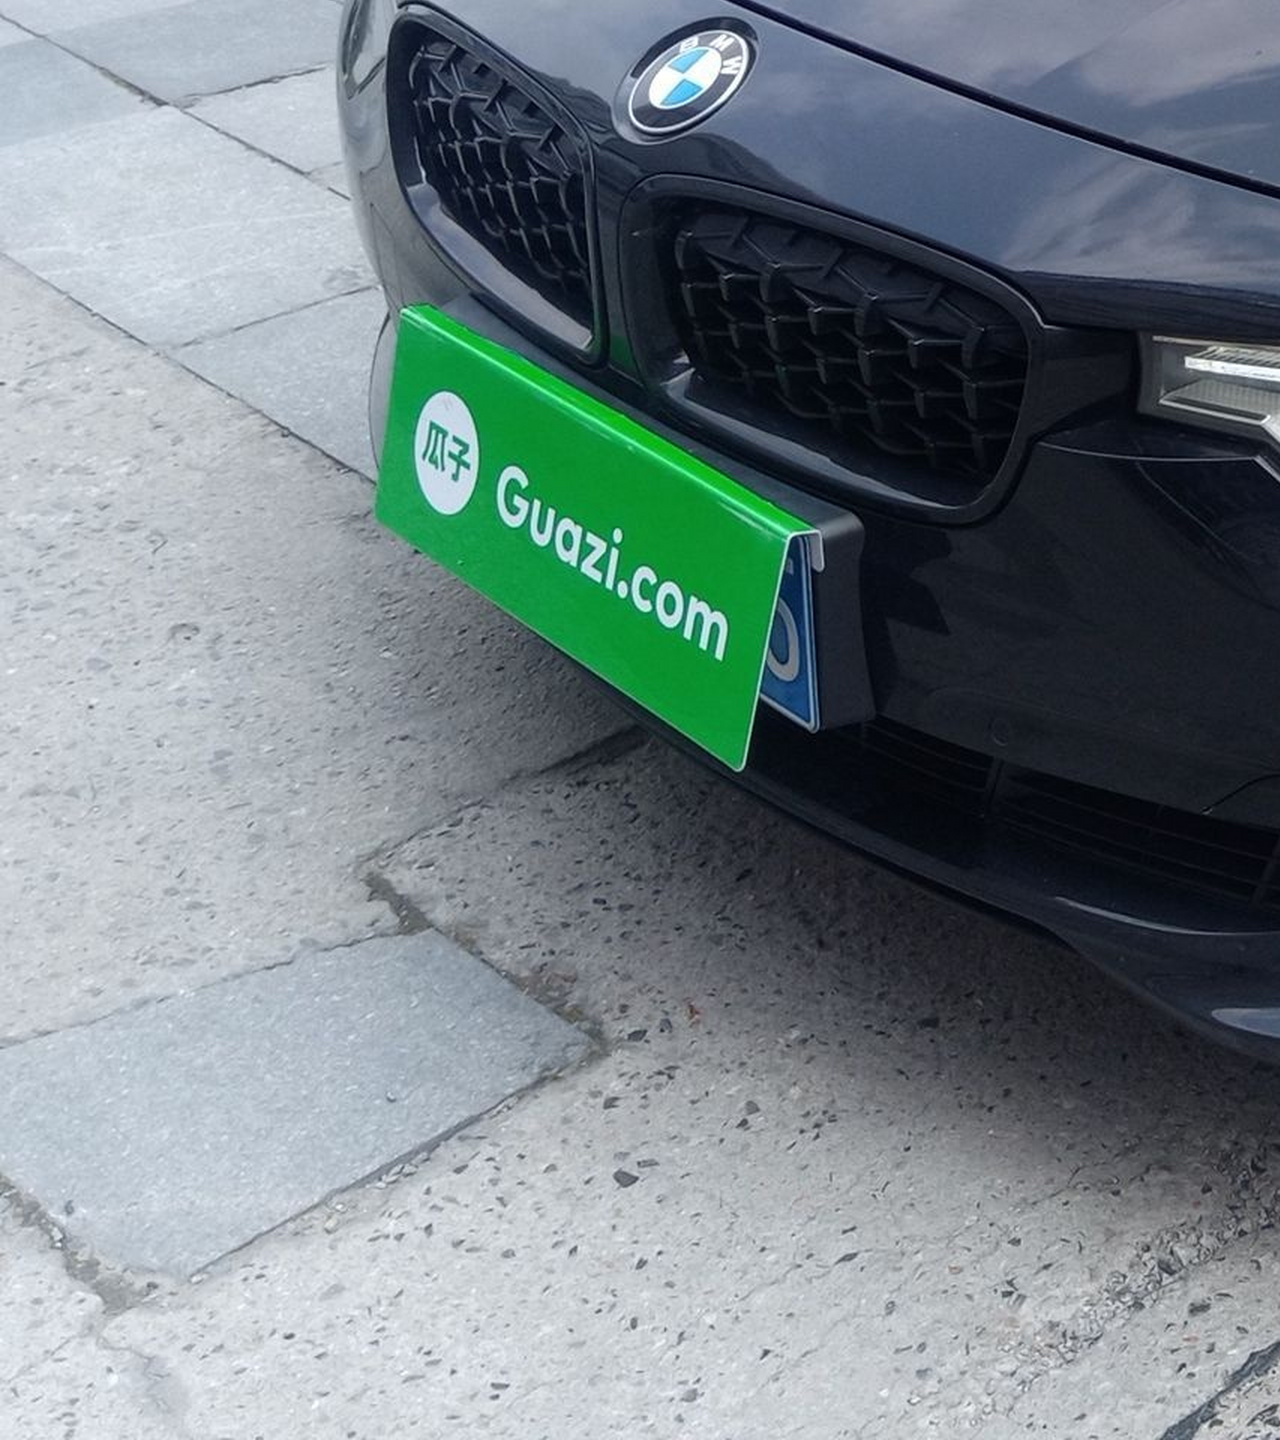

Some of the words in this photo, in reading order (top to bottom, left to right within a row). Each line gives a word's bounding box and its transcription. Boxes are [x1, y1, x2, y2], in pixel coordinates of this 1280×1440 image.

[679, 33, 743, 75] BMW
[422, 420, 471, 483] 瓜子
[496, 465, 729, 662] Guazi.com
